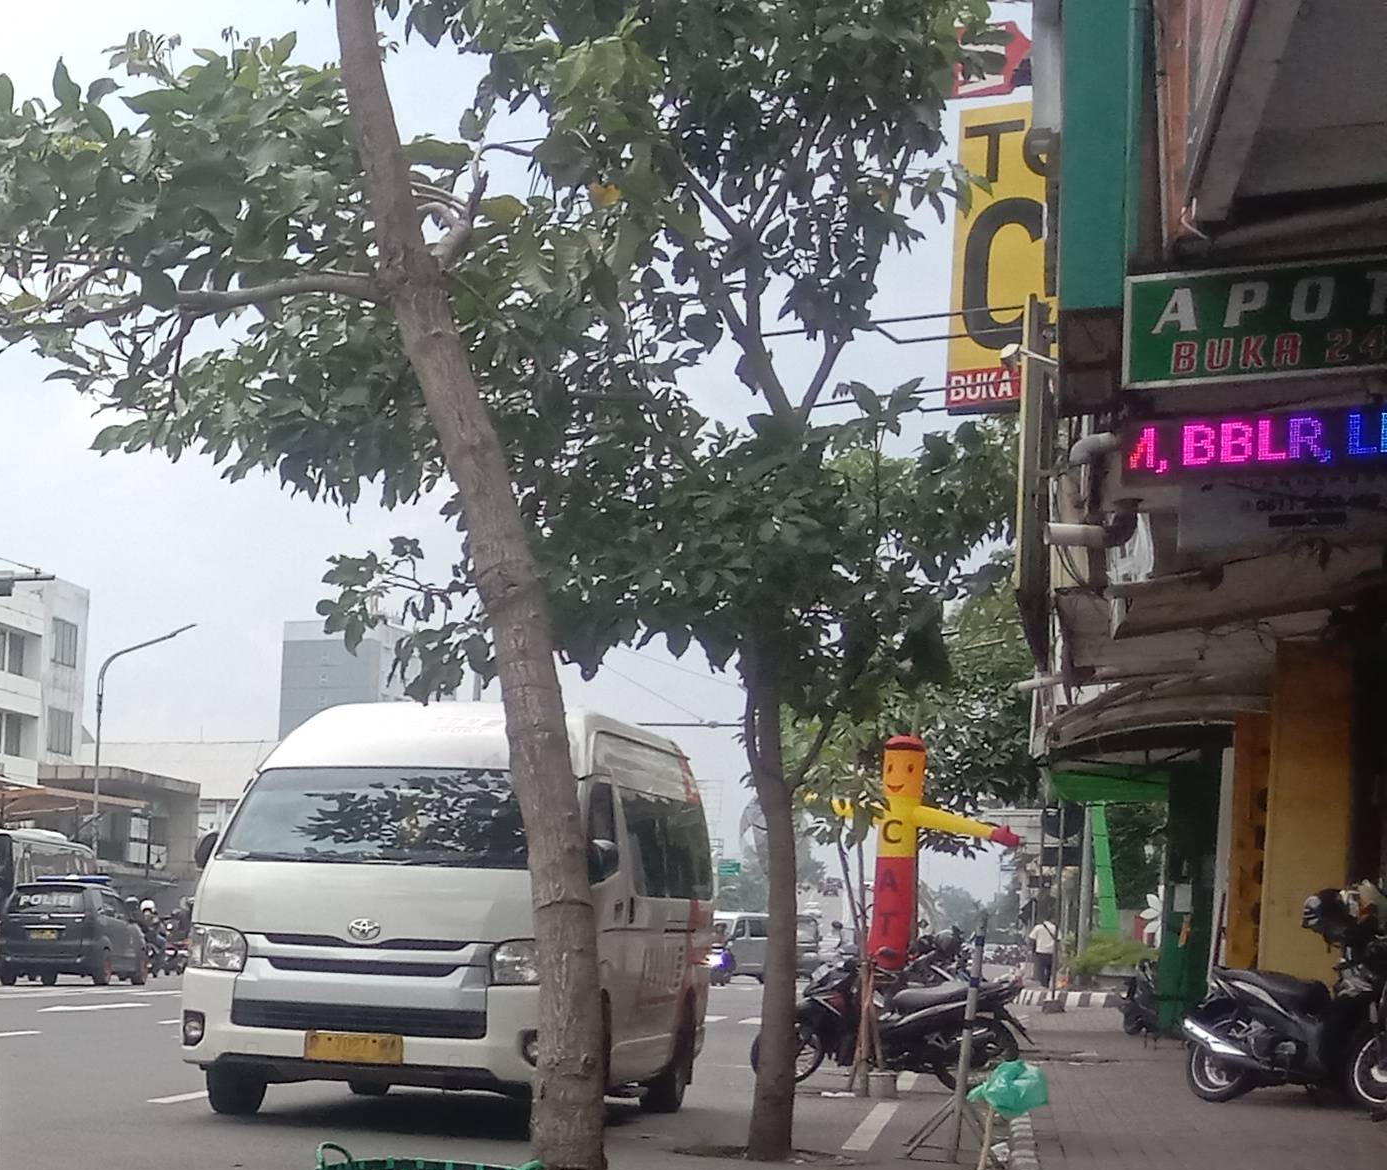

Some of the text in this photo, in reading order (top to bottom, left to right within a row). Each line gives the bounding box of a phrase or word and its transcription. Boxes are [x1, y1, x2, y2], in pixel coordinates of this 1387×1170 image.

[1171, 332, 1302, 375] BUKA
[950, 370, 1013, 401] BUKA
[18, 893, 76, 907] POLISI
